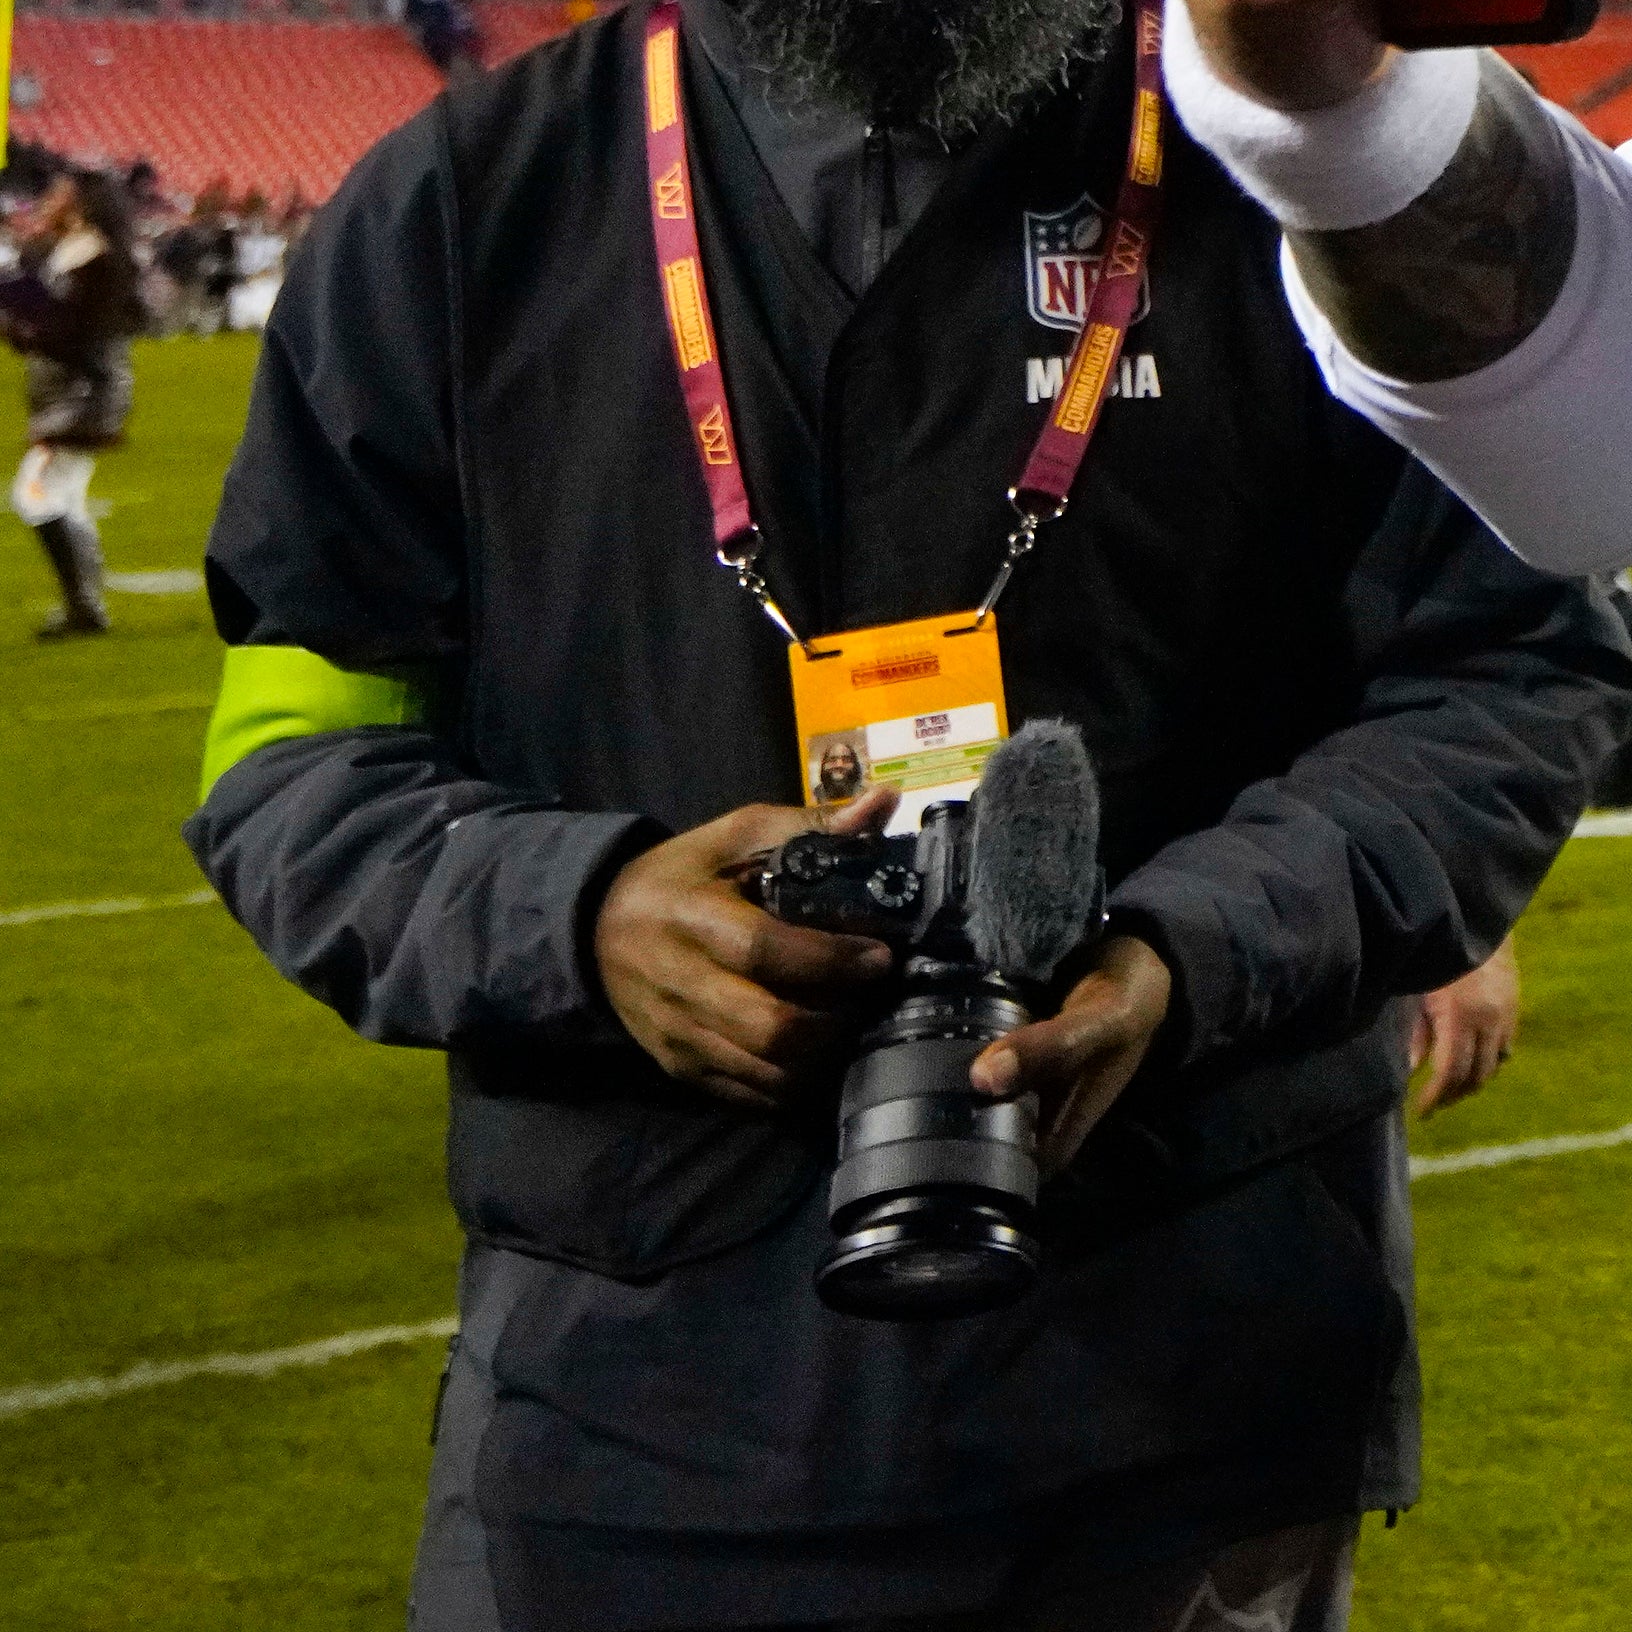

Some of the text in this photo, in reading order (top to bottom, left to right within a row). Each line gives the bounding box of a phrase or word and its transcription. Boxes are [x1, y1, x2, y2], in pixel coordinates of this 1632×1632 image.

[669, 259, 708, 369] COMMANDERS
[1026, 354, 1161, 404] MIA
[1061, 322, 1115, 432] COMMANDERS
